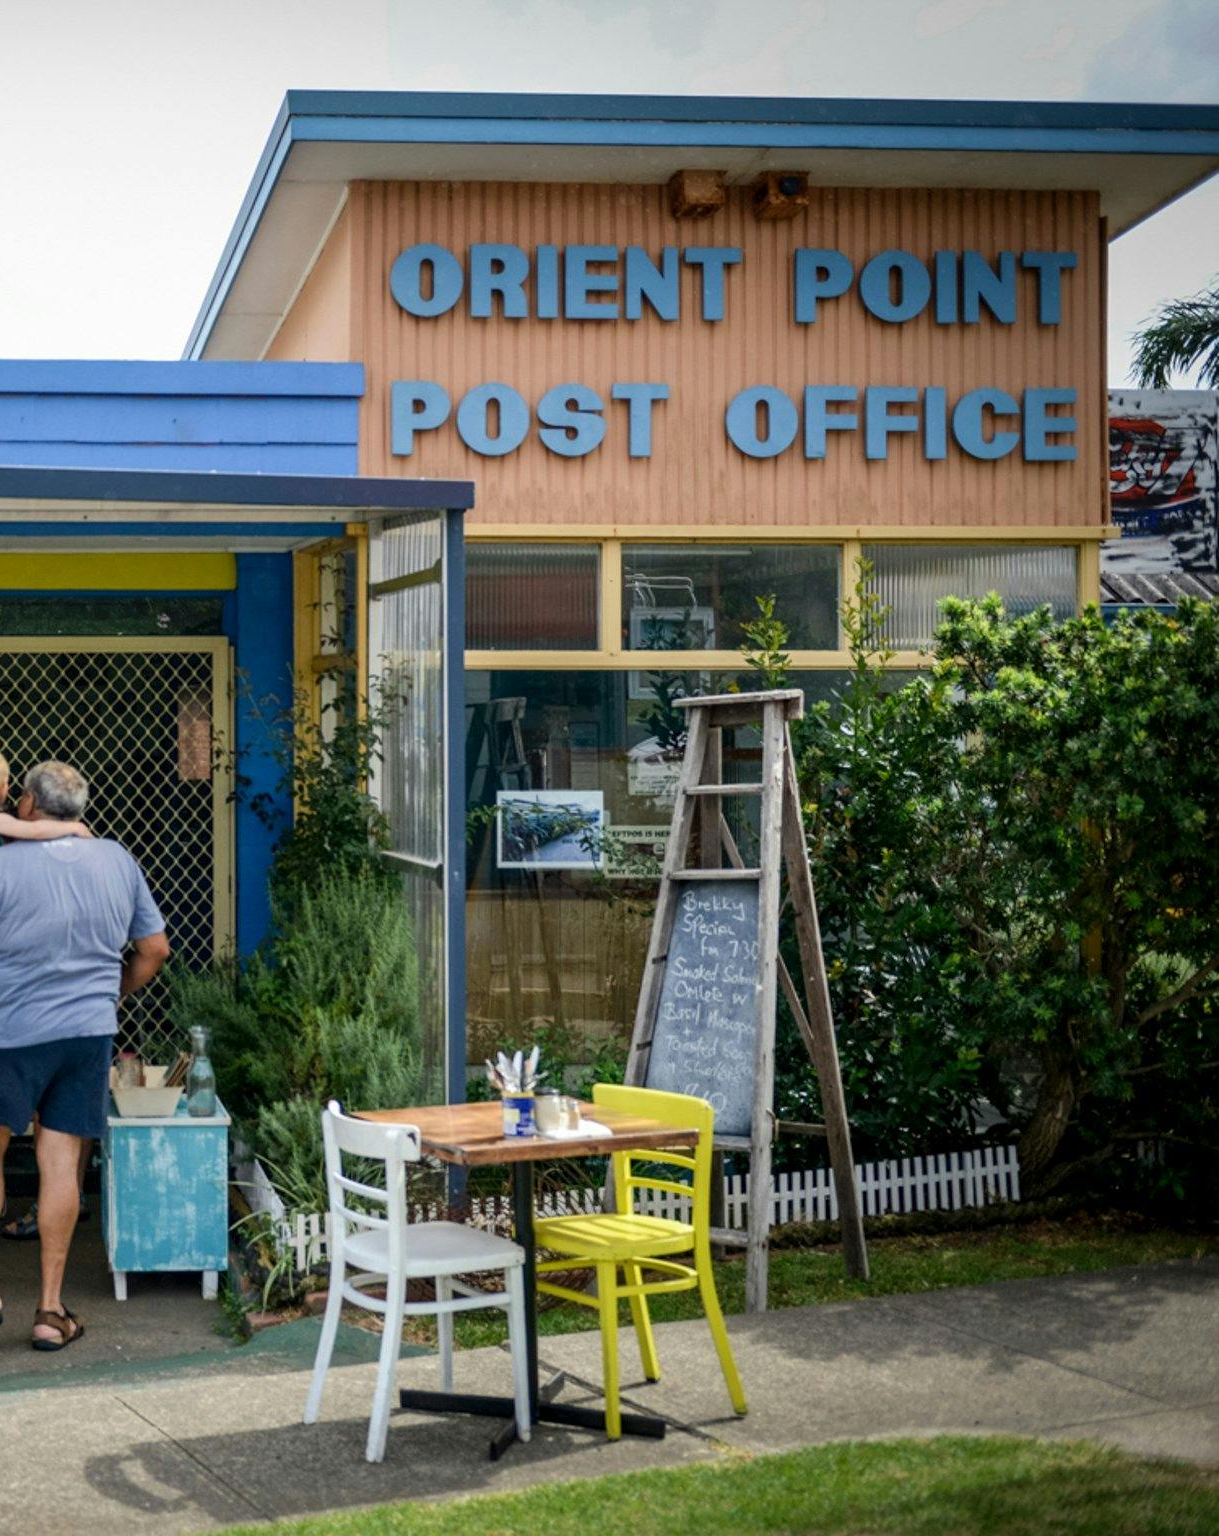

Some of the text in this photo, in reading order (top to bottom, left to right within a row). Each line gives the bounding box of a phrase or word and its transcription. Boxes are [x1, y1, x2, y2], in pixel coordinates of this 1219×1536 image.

[390, 243, 1077, 325] ORIENT POINT
[390, 380, 670, 458] POST
[724, 384, 1078, 462] OFFICE
[682, 890, 745, 921] Brekky
